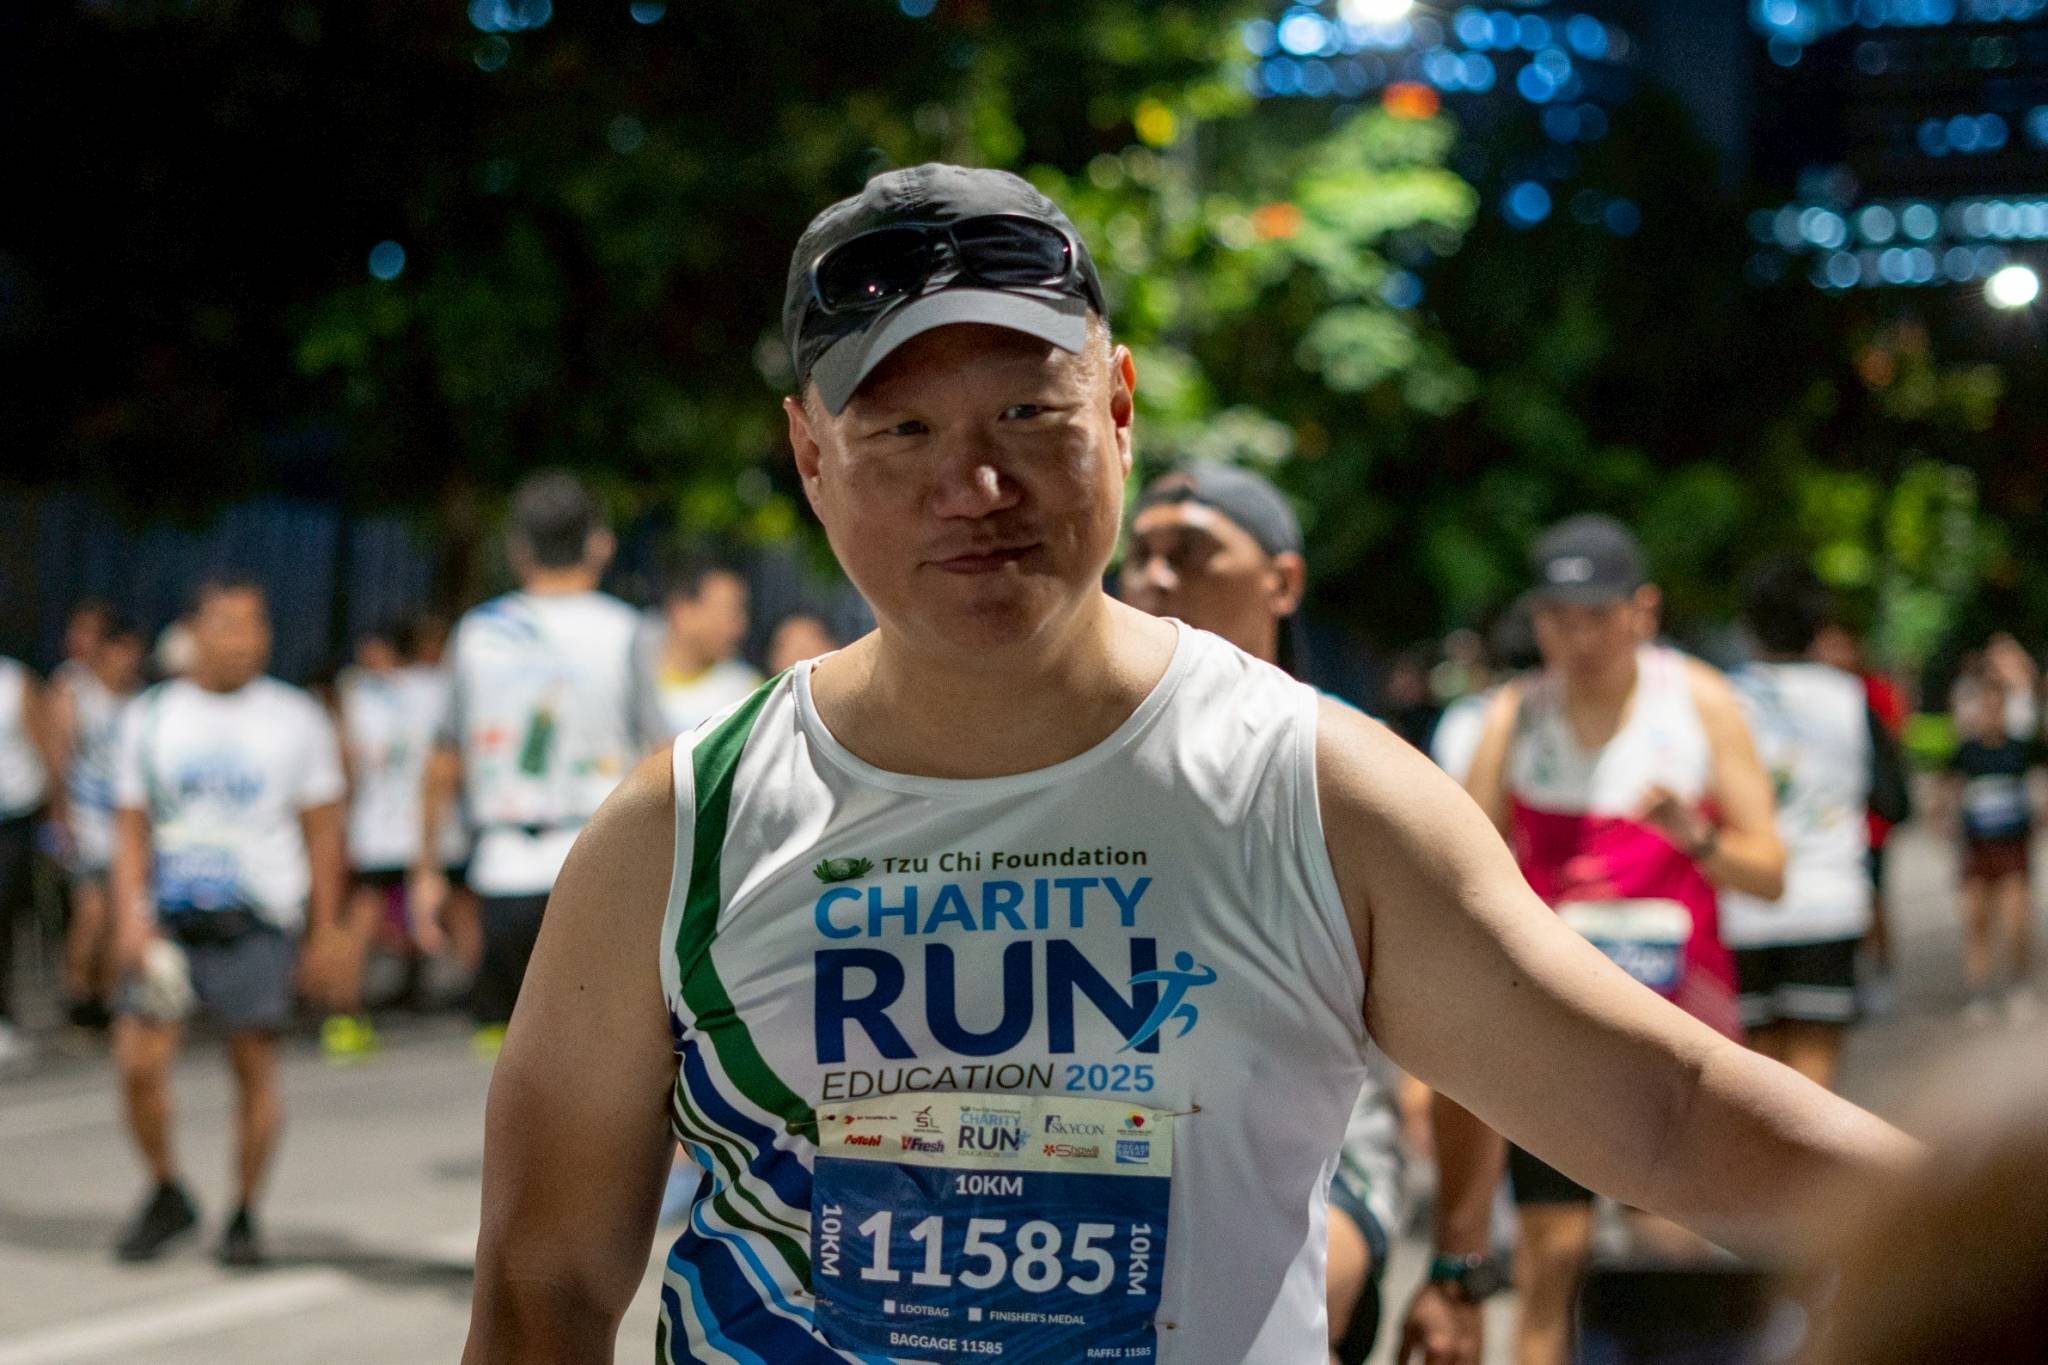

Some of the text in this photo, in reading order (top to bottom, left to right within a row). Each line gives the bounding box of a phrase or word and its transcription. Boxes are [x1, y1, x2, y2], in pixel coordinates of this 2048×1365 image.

[883, 846, 1147, 873] Tzu Chi Foundation
[814, 877, 1152, 939] CHARITY
[814, 937, 1160, 1064] RUN
[822, 1063, 1155, 1100] EDUCATION 2025
[960, 1113, 1021, 1125] CHARITY
[1052, 1122, 1105, 1136] SKYCON
[958, 1125, 1021, 1151] RUN
[955, 1174, 1024, 1197] 10KM
[820, 1204, 843, 1277] 10KM
[858, 1210, 1116, 1295] 11585
[1126, 1223, 1151, 1296] 10KM
[900, 1303, 950, 1318] LOOTBAG
[989, 1310, 1086, 1325] FINISHER'S MEDAL
[890, 1332, 1003, 1355] BAGGAGE 11585
[1087, 1346, 1152, 1358] RAFFLE 11585
